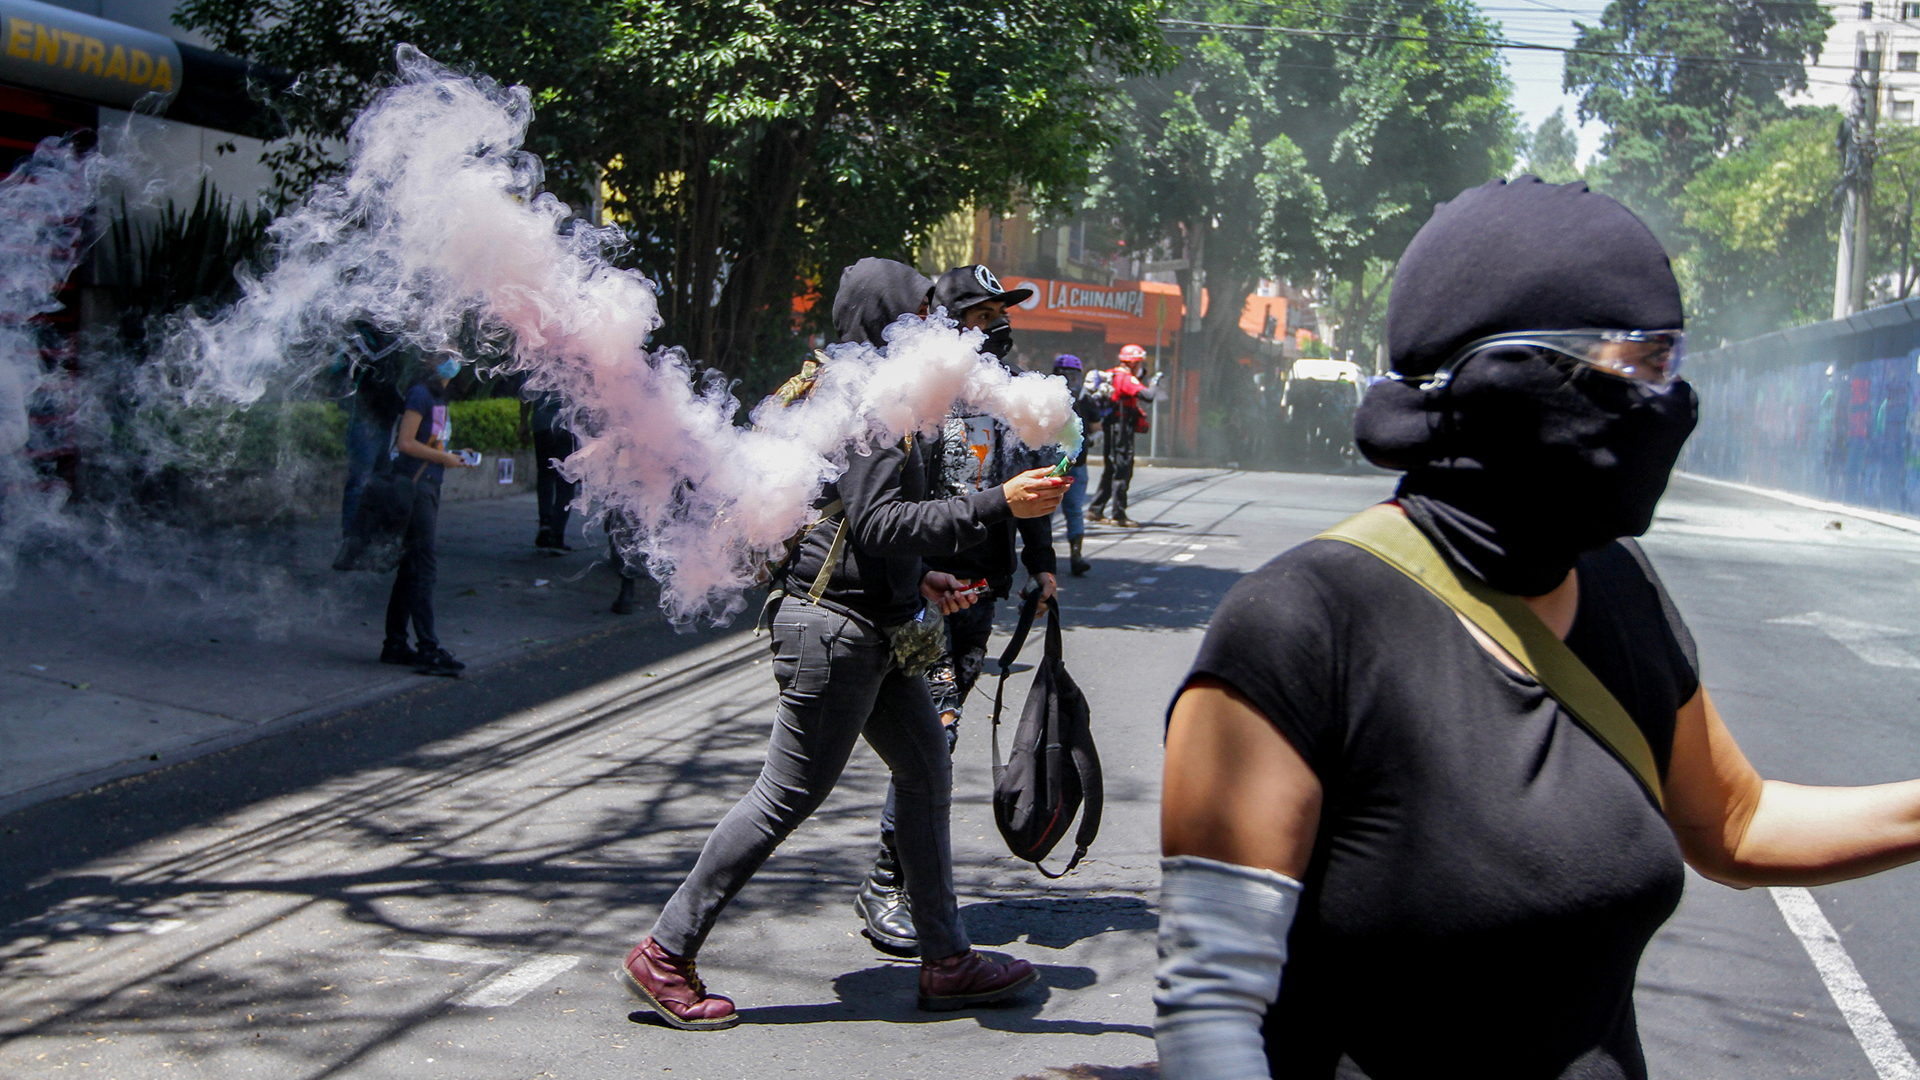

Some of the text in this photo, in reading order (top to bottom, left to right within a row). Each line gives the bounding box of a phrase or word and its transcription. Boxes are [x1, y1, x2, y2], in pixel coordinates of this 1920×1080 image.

[7, 18, 172, 91] ENTRADA
[1048, 280, 1144, 318] LA CHINAMPA
